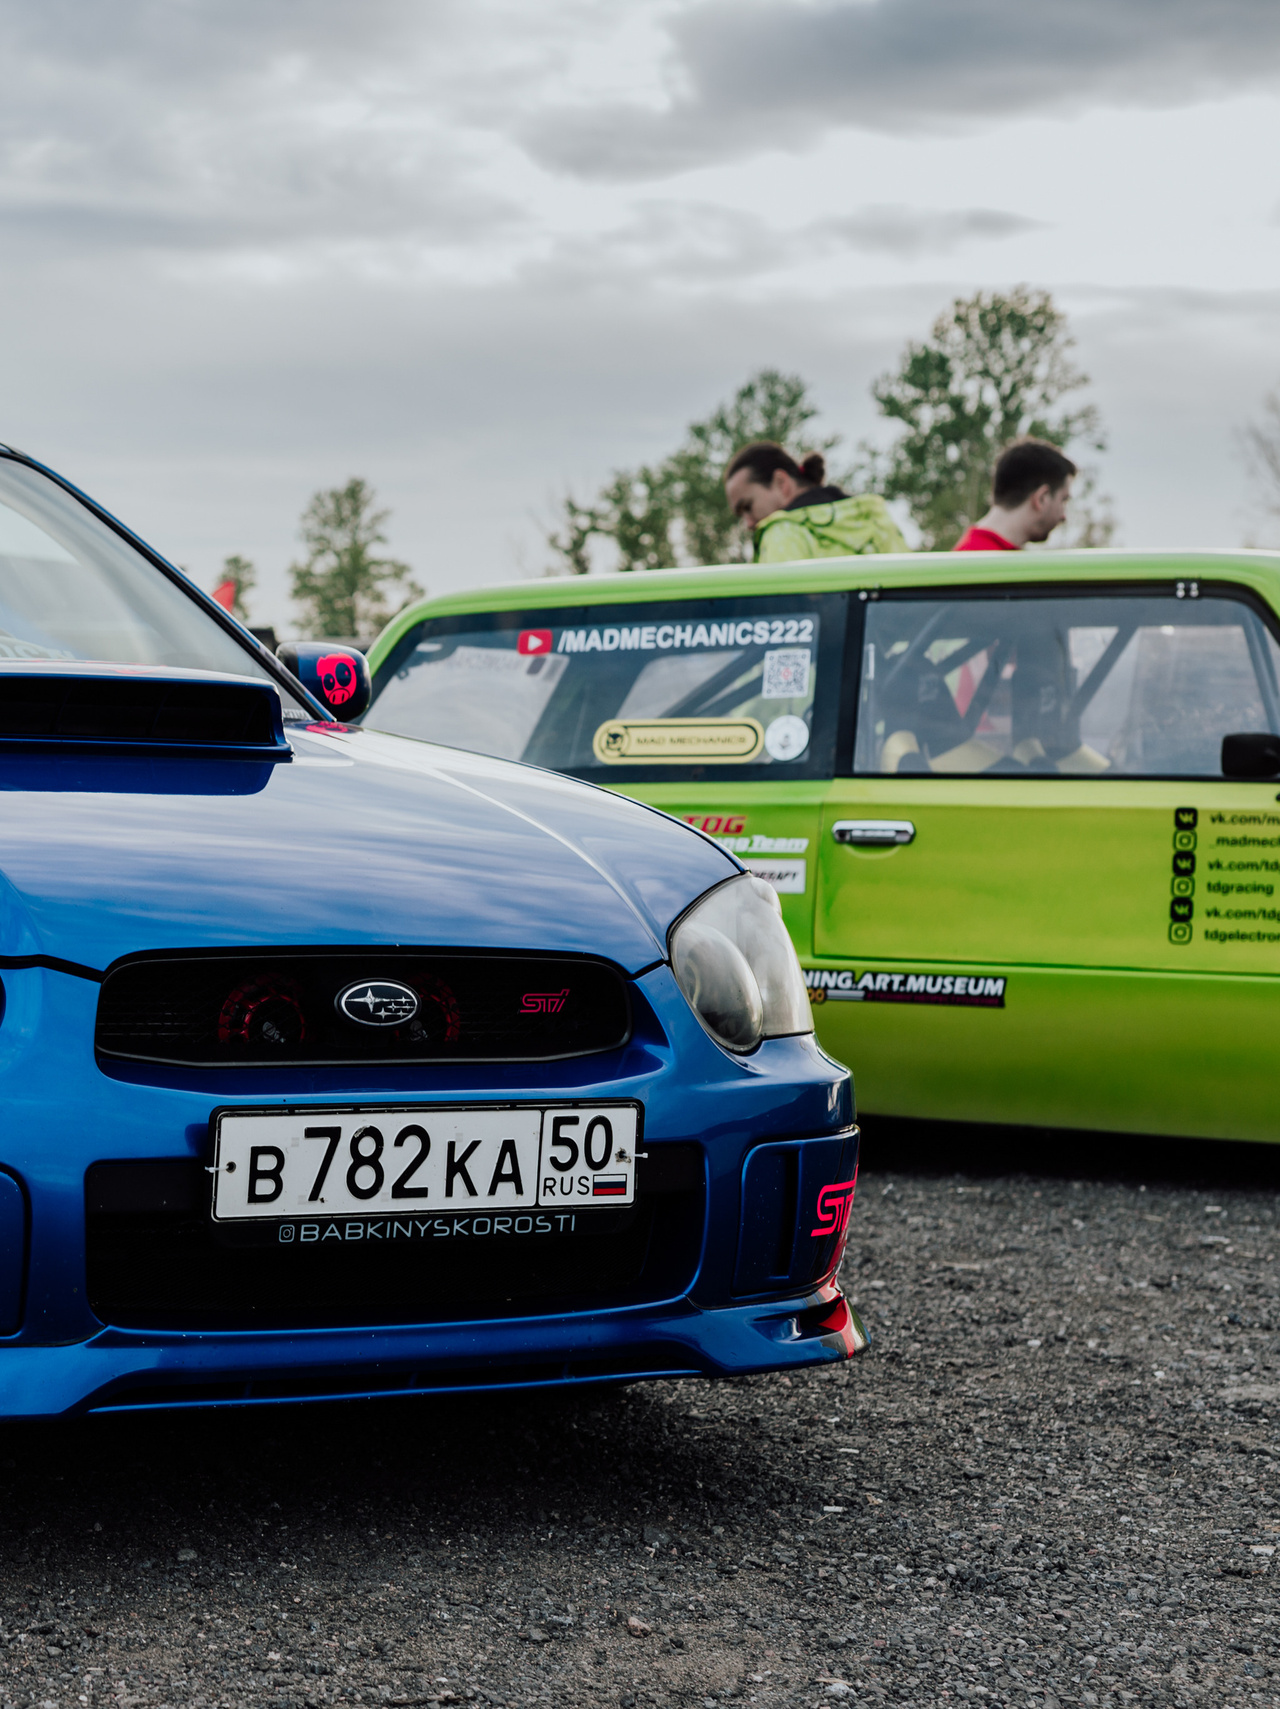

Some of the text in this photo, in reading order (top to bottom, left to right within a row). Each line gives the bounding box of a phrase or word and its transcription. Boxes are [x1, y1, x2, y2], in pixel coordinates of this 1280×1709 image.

[557, 619, 814, 653] /MADMECHANICS222
[1208, 859, 1280, 873] vk.com/td
[1206, 881, 1274, 897] tdgracing
[548, 1115, 614, 1172] 50
[542, 1176, 590, 1197] RUS
[299, 1215, 576, 1242] BABKINYSKOROSTI
